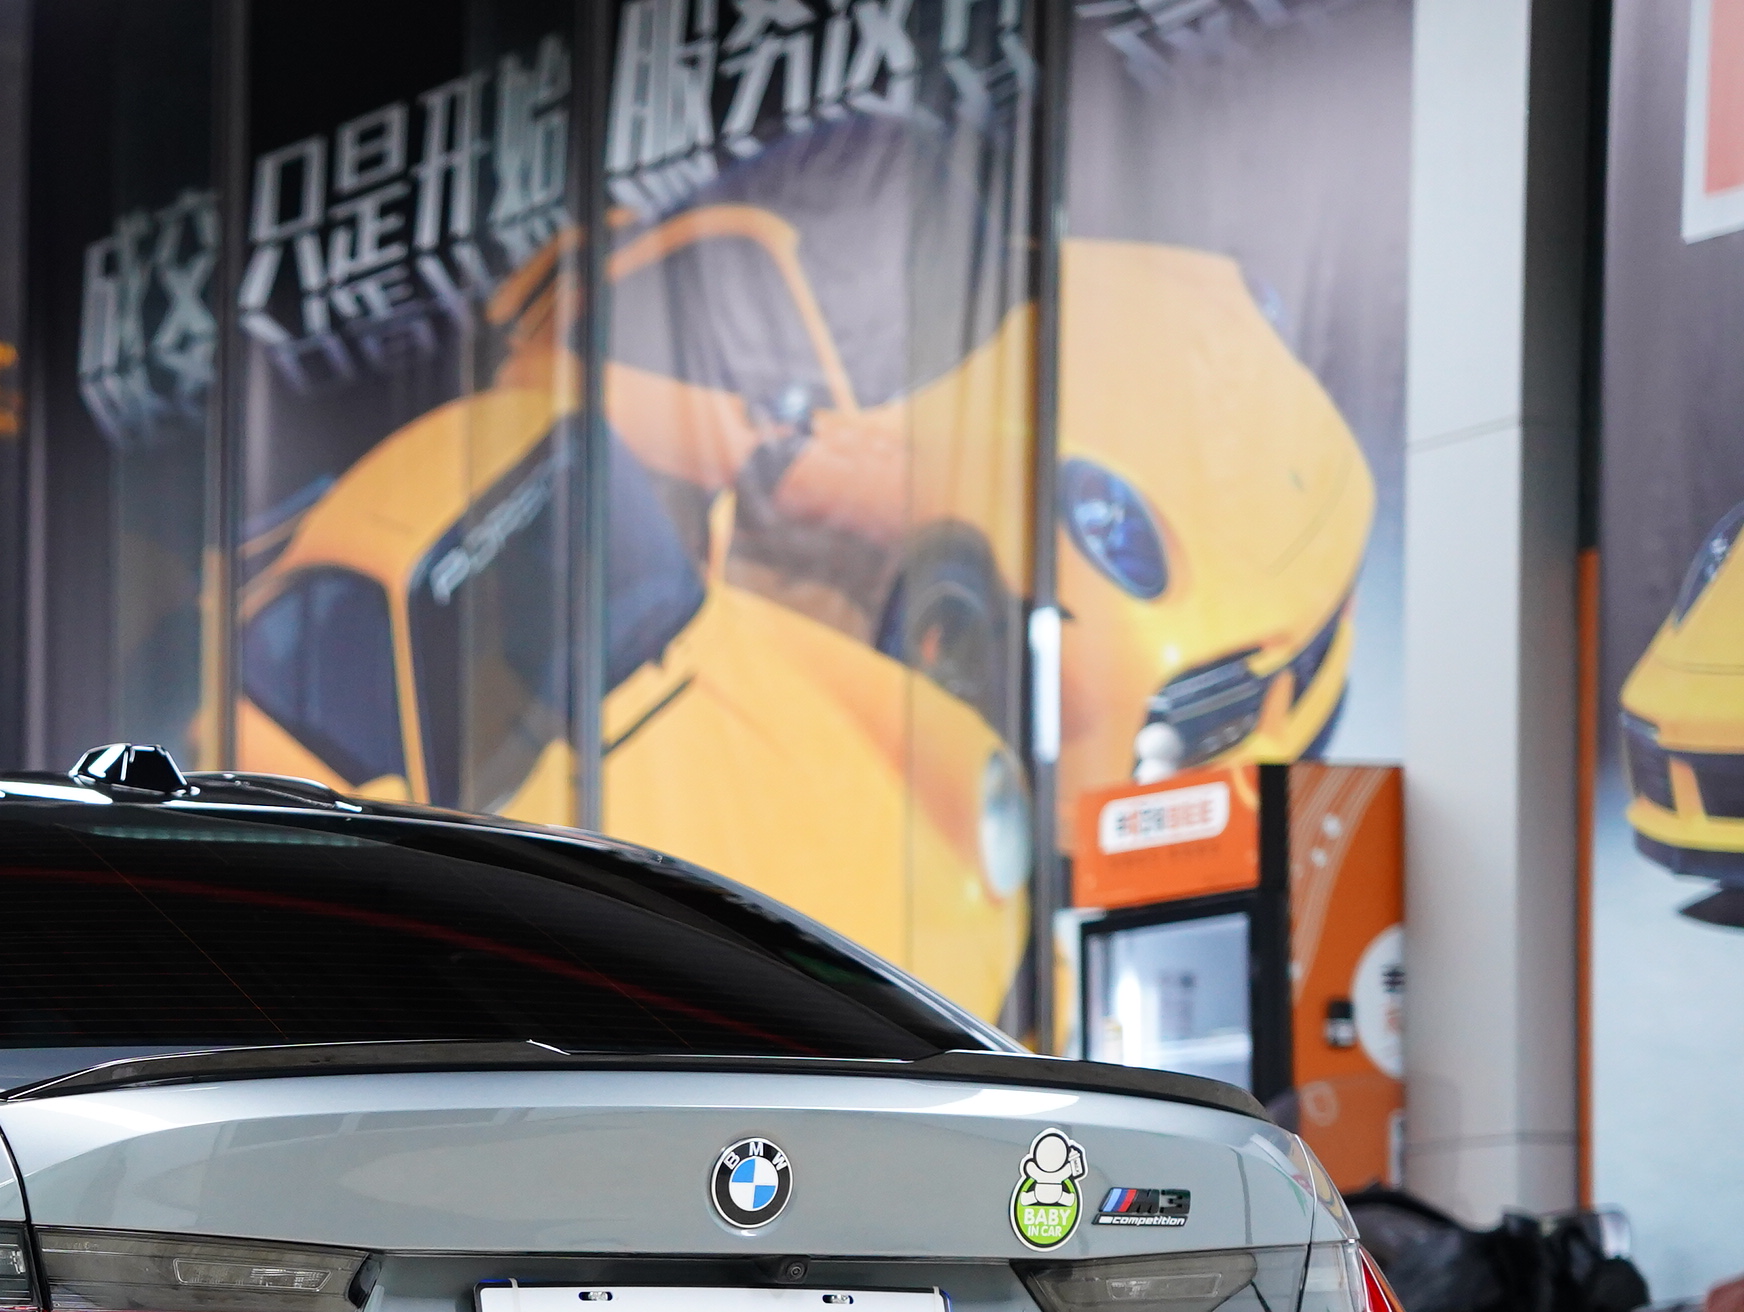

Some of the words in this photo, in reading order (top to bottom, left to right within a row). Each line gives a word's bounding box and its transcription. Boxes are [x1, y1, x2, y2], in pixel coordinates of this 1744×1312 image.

[723, 1141, 788, 1171] BMW
[1023, 1208, 1072, 1226] BABY
[1111, 1215, 1186, 1226] competition
[1027, 1226, 1039, 1237] IN
[1040, 1225, 1062, 1237] CAR
